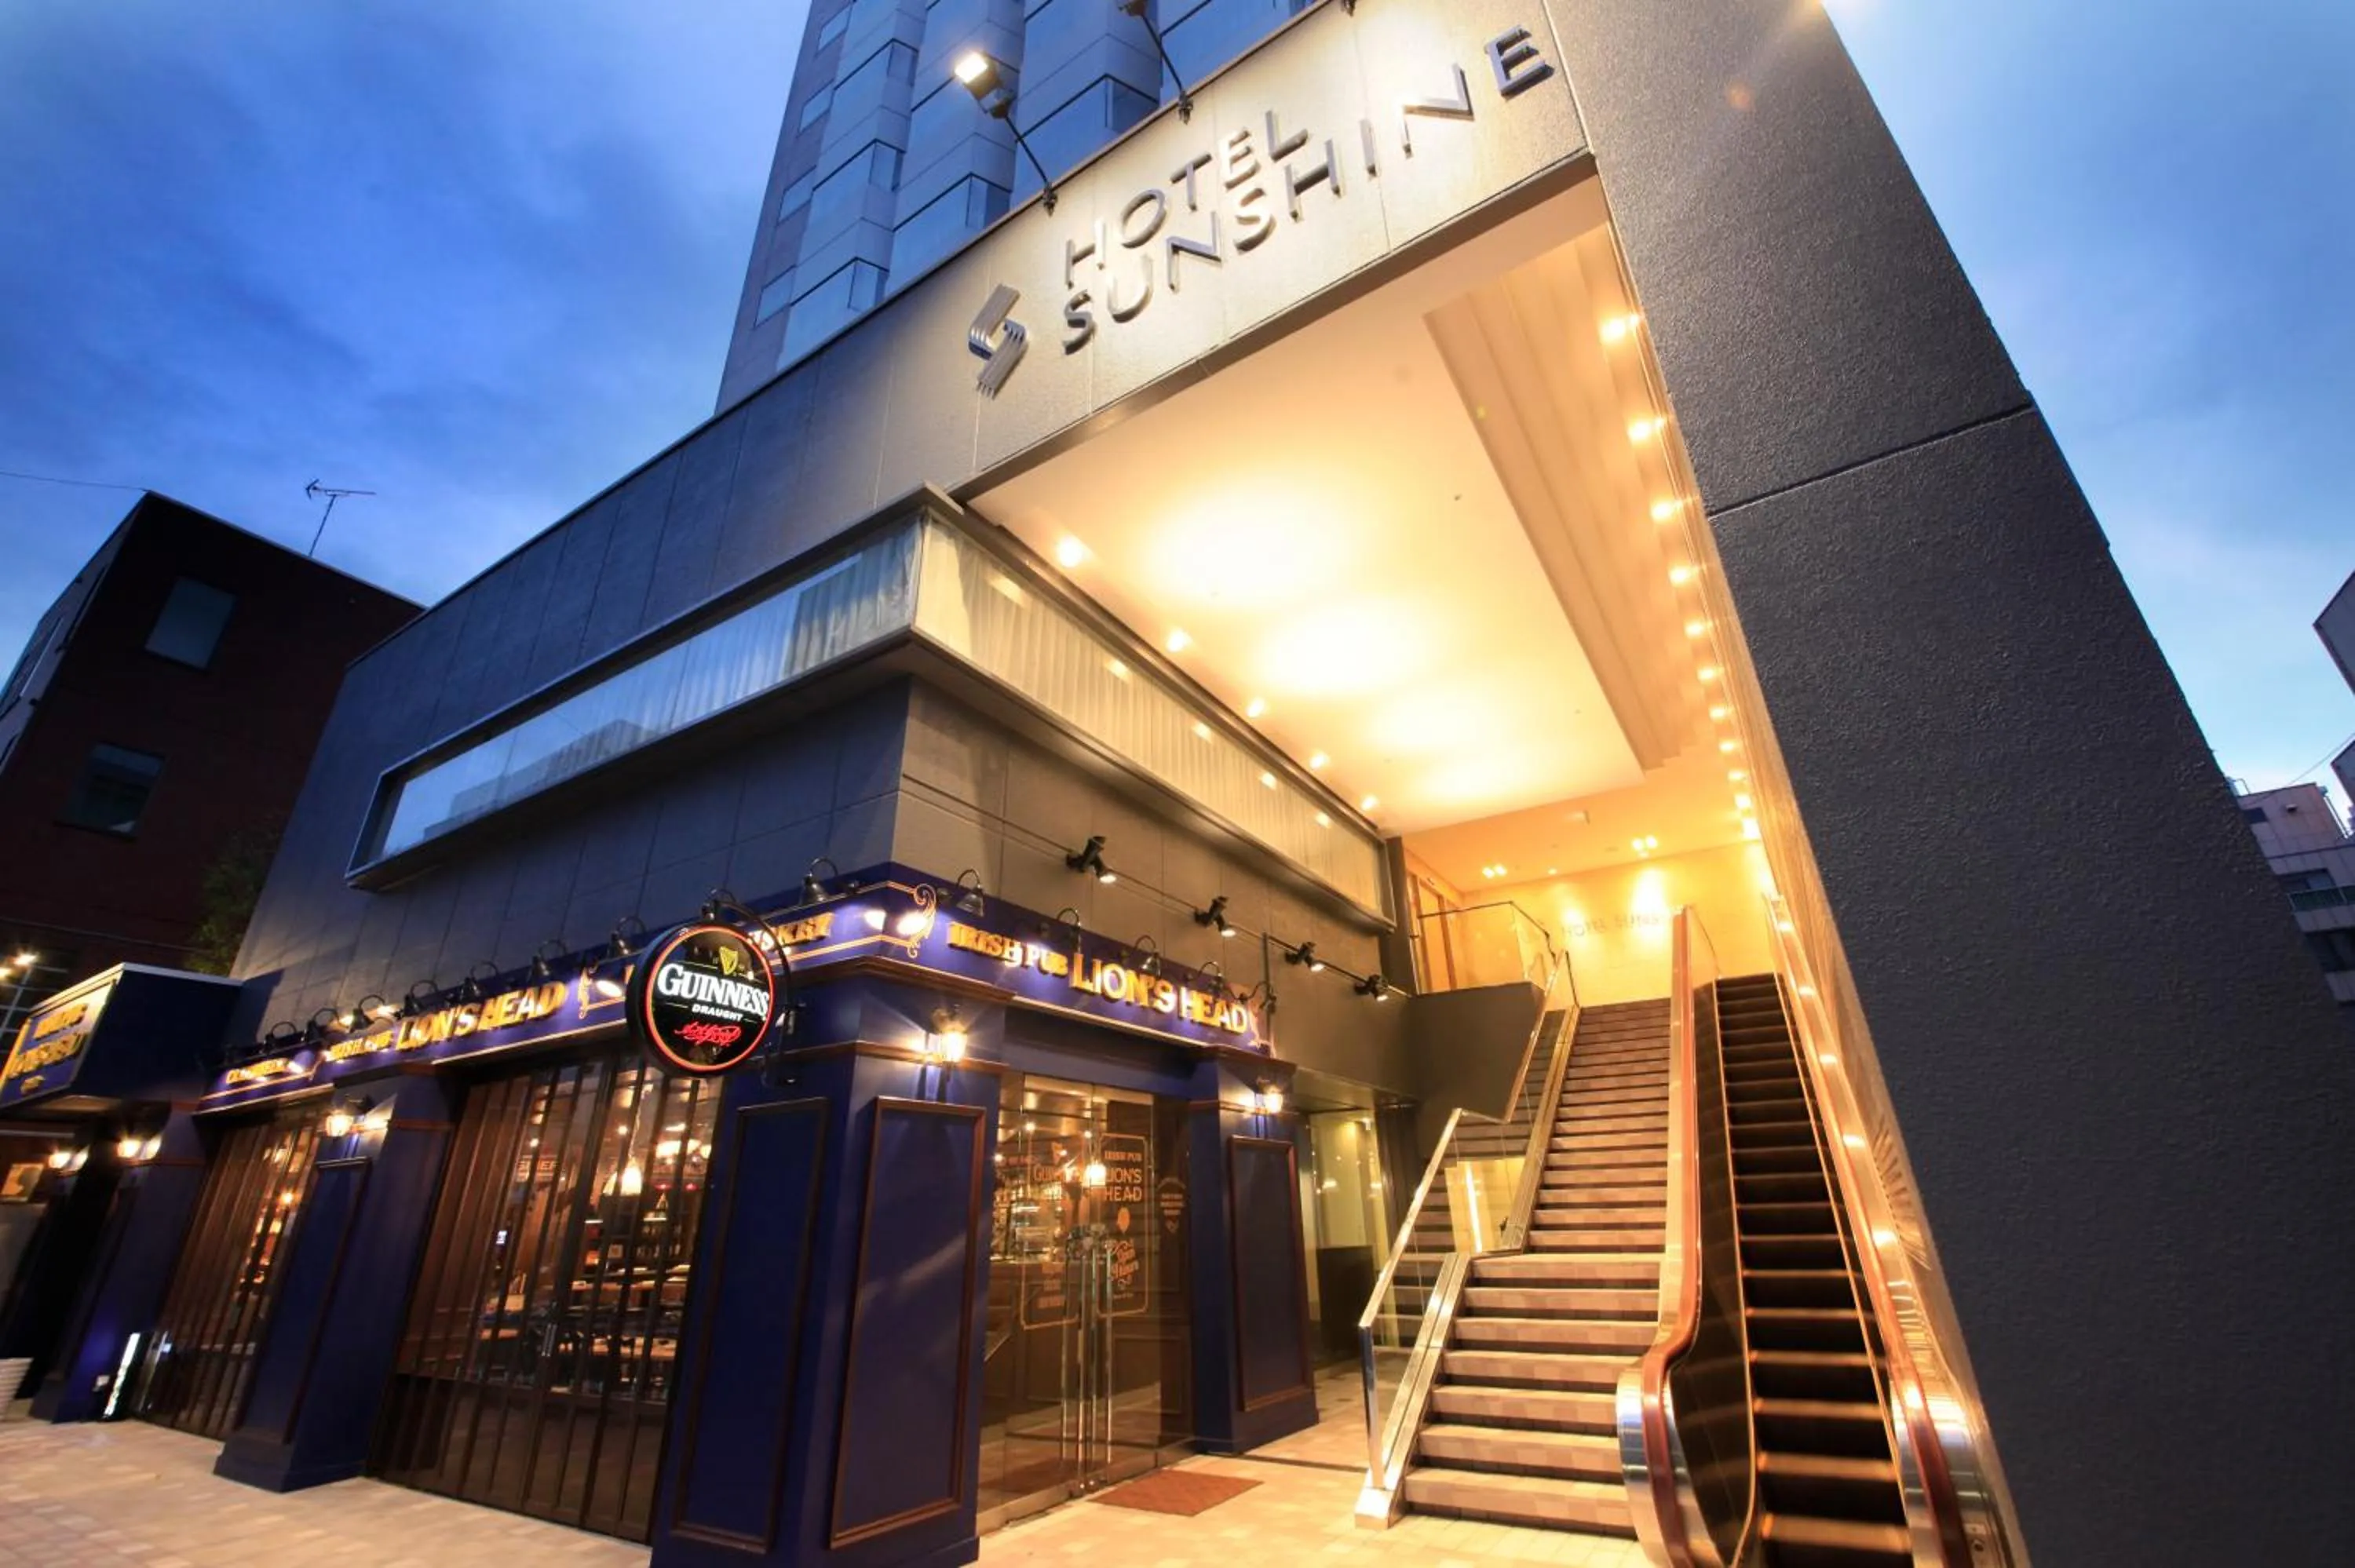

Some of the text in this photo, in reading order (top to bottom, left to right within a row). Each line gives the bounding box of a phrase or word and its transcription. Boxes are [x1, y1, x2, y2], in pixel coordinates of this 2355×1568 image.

[1063, 24, 1554, 355] SUNSHINE
[1065, 109, 1309, 290] HOTEL
[478, 982, 567, 1030] HEAD
[658, 963, 769, 1020] GUINNESS
[692, 1004, 743, 1021] DRAUGHT
[1070, 953, 1176, 1014] LION'S
[1179, 986, 1247, 1034] HEAD
[1104, 1187, 1142, 1202] HEAD
